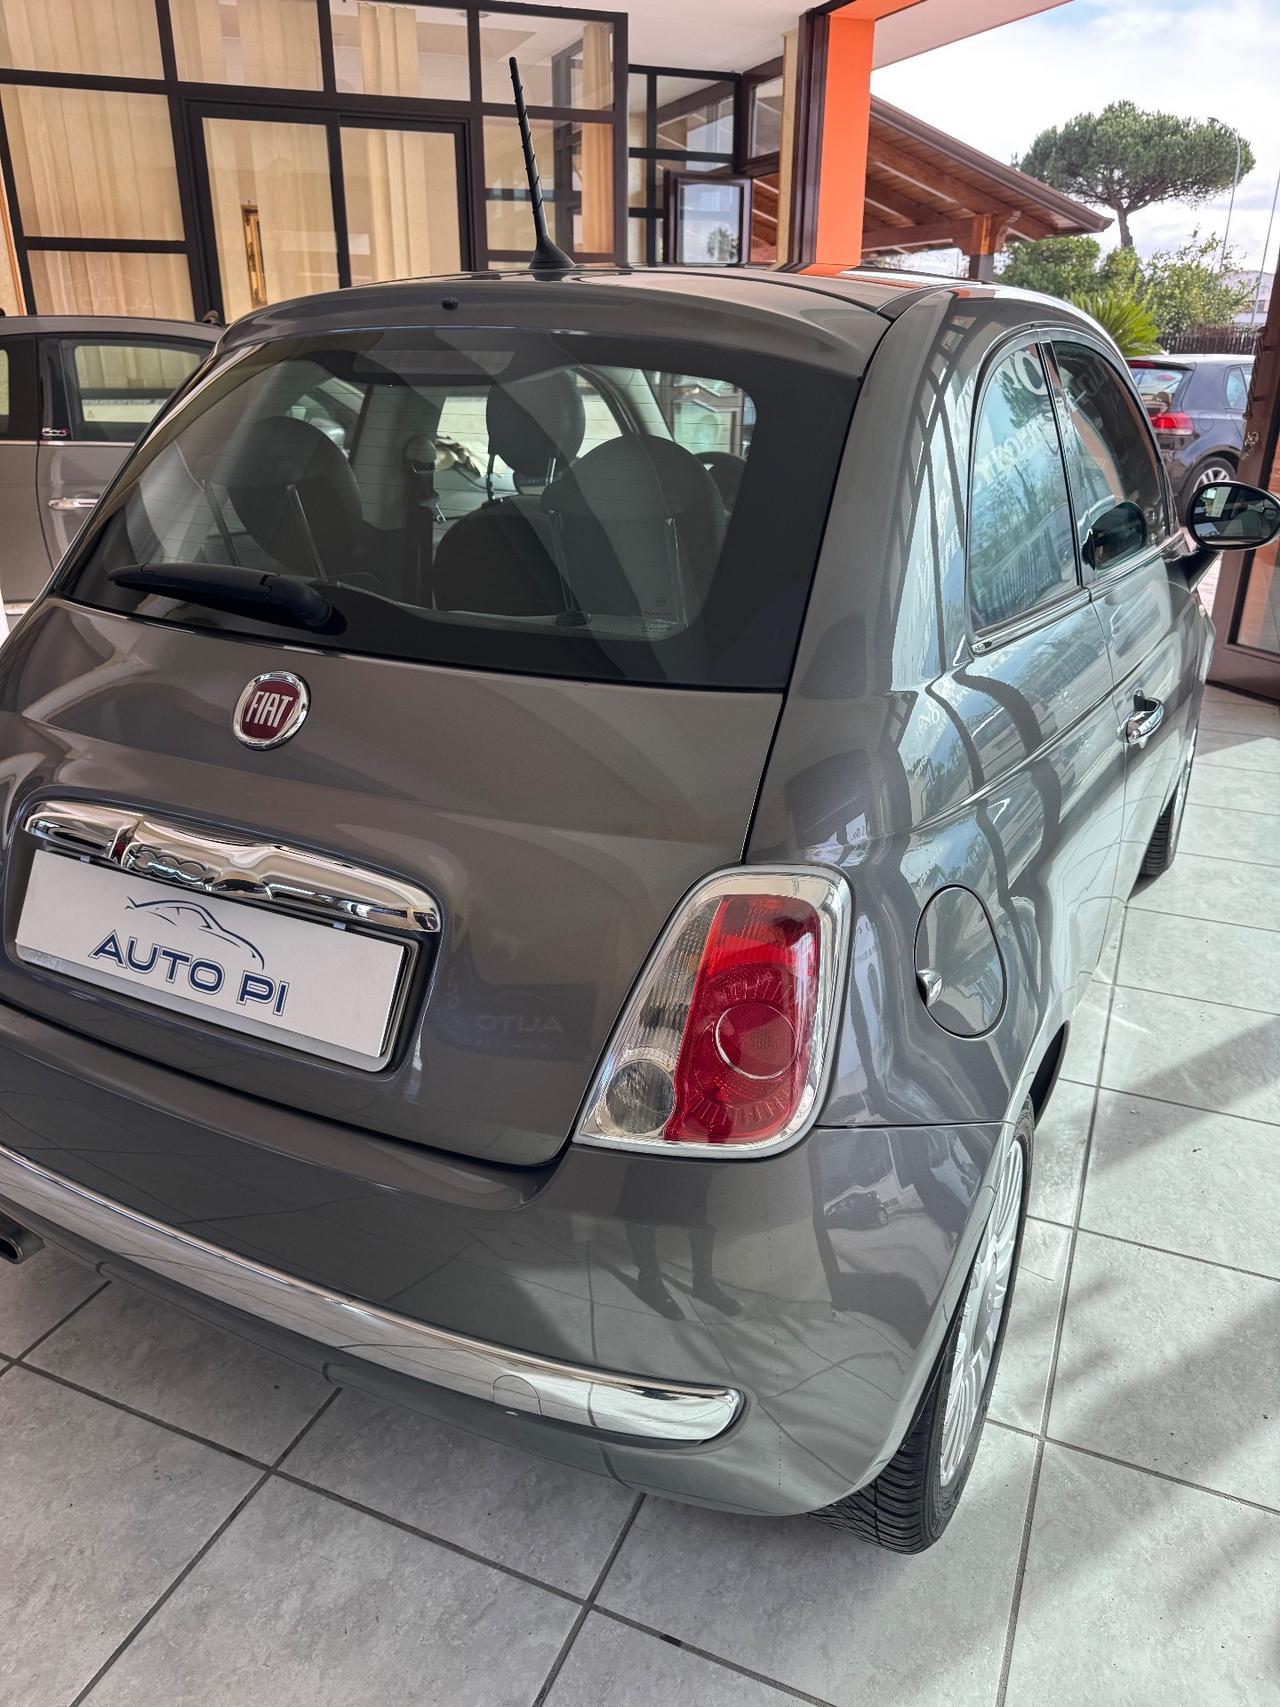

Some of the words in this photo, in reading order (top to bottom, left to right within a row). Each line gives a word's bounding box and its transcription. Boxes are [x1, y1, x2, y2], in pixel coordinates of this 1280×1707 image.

[245, 690, 293, 728] FIAT
[131, 844, 208, 885] 500
[88, 929, 226, 996] AUTO
[236, 969, 290, 1017] PI
